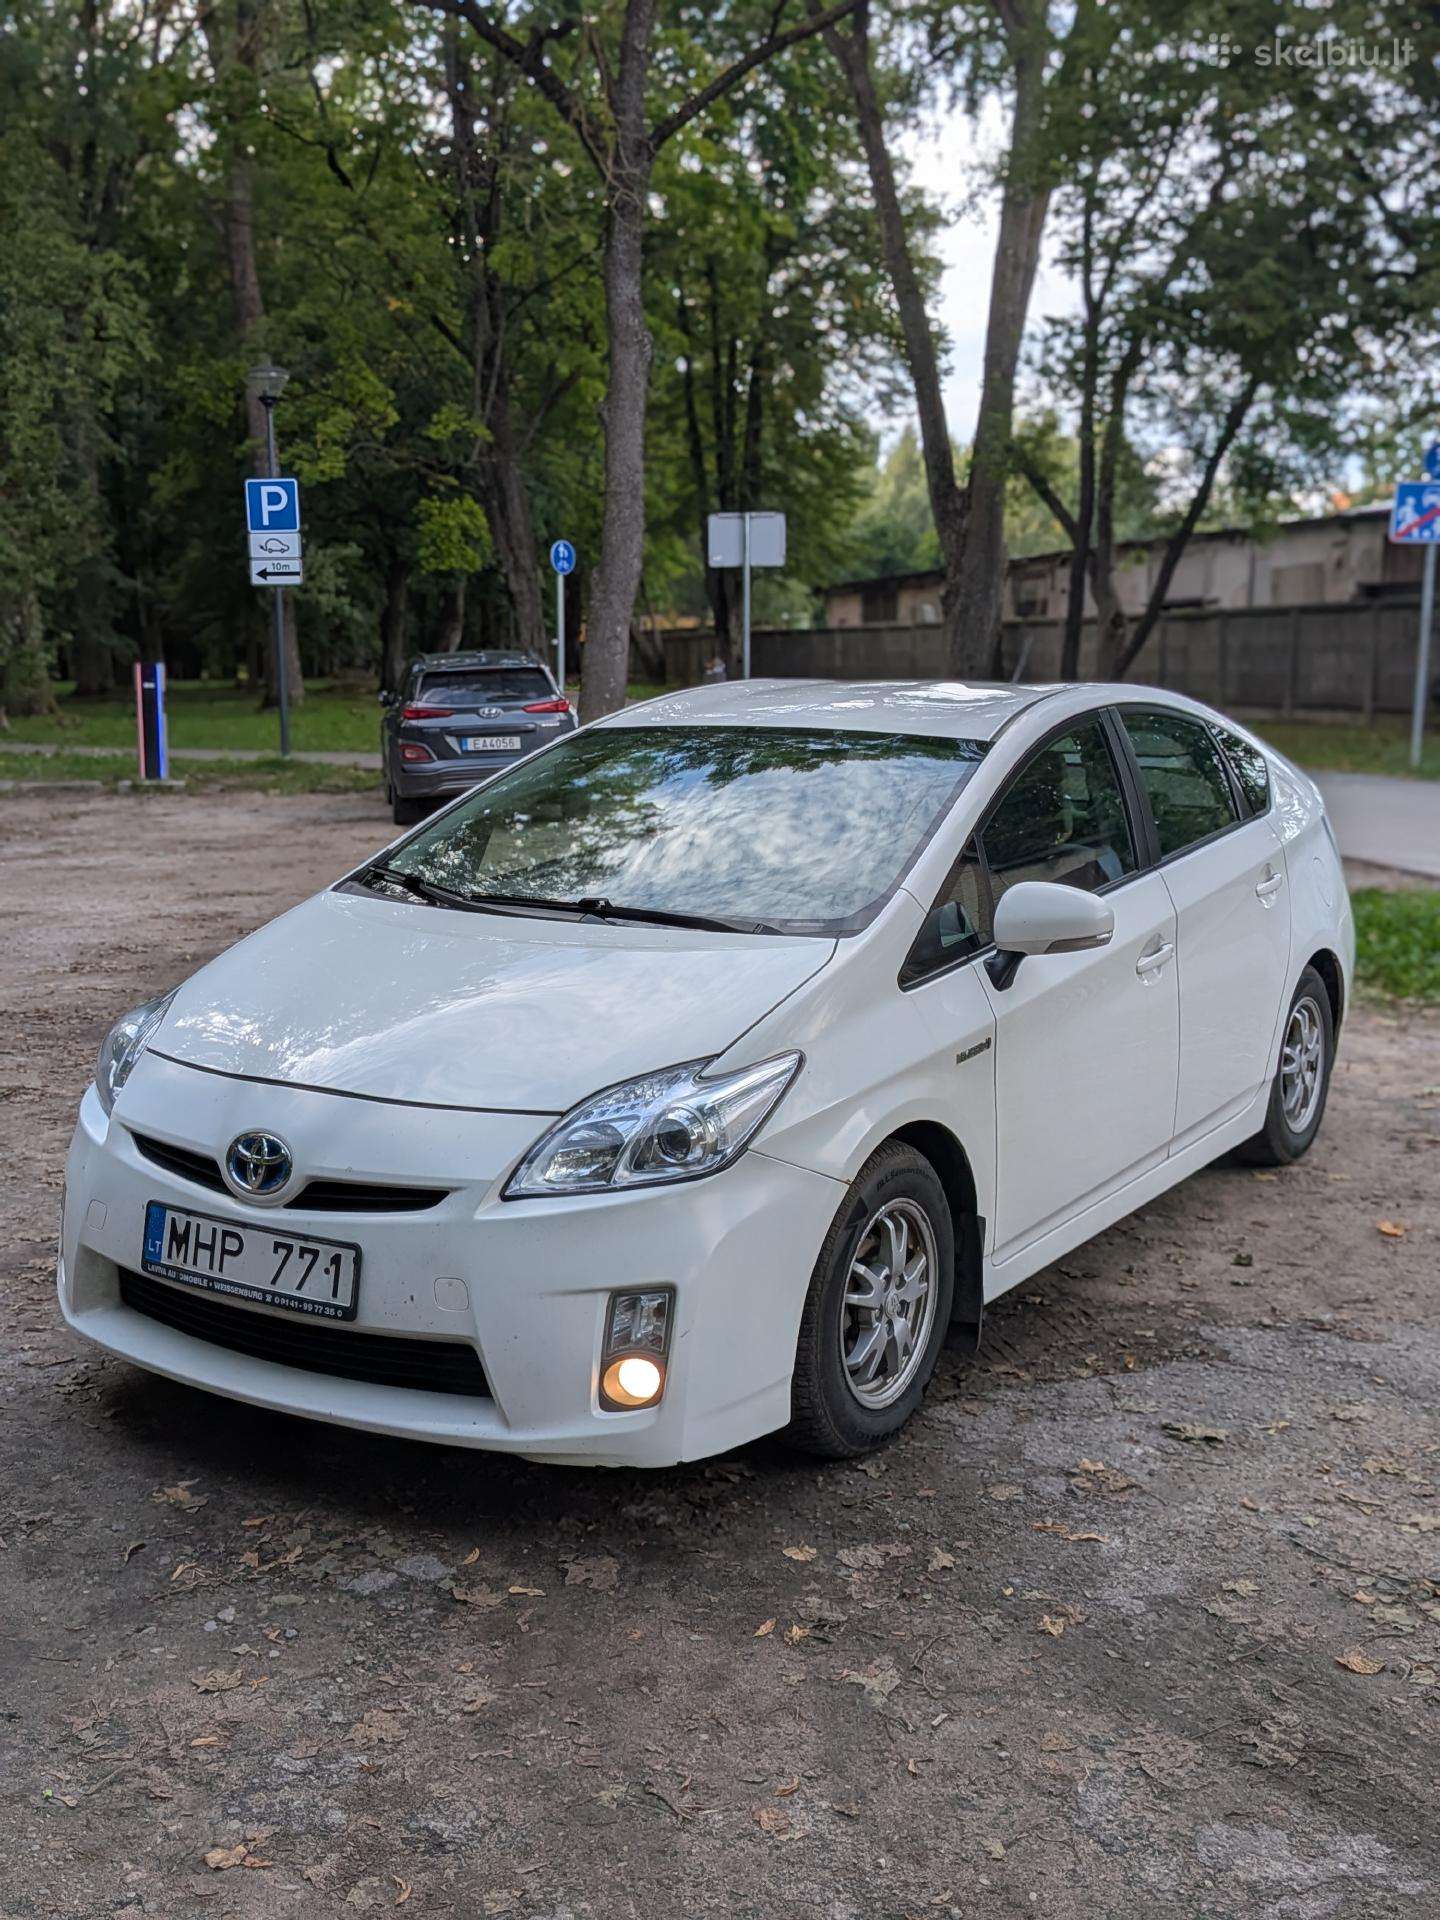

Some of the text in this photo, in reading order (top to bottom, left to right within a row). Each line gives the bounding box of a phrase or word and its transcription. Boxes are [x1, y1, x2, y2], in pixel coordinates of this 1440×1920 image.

[260, 485, 288, 526] P
[272, 562, 290, 571] 10m
[473, 738, 514, 749] EA4056
[148, 1239, 161, 1254] LT
[167, 1216, 342, 1299] MHP 771
